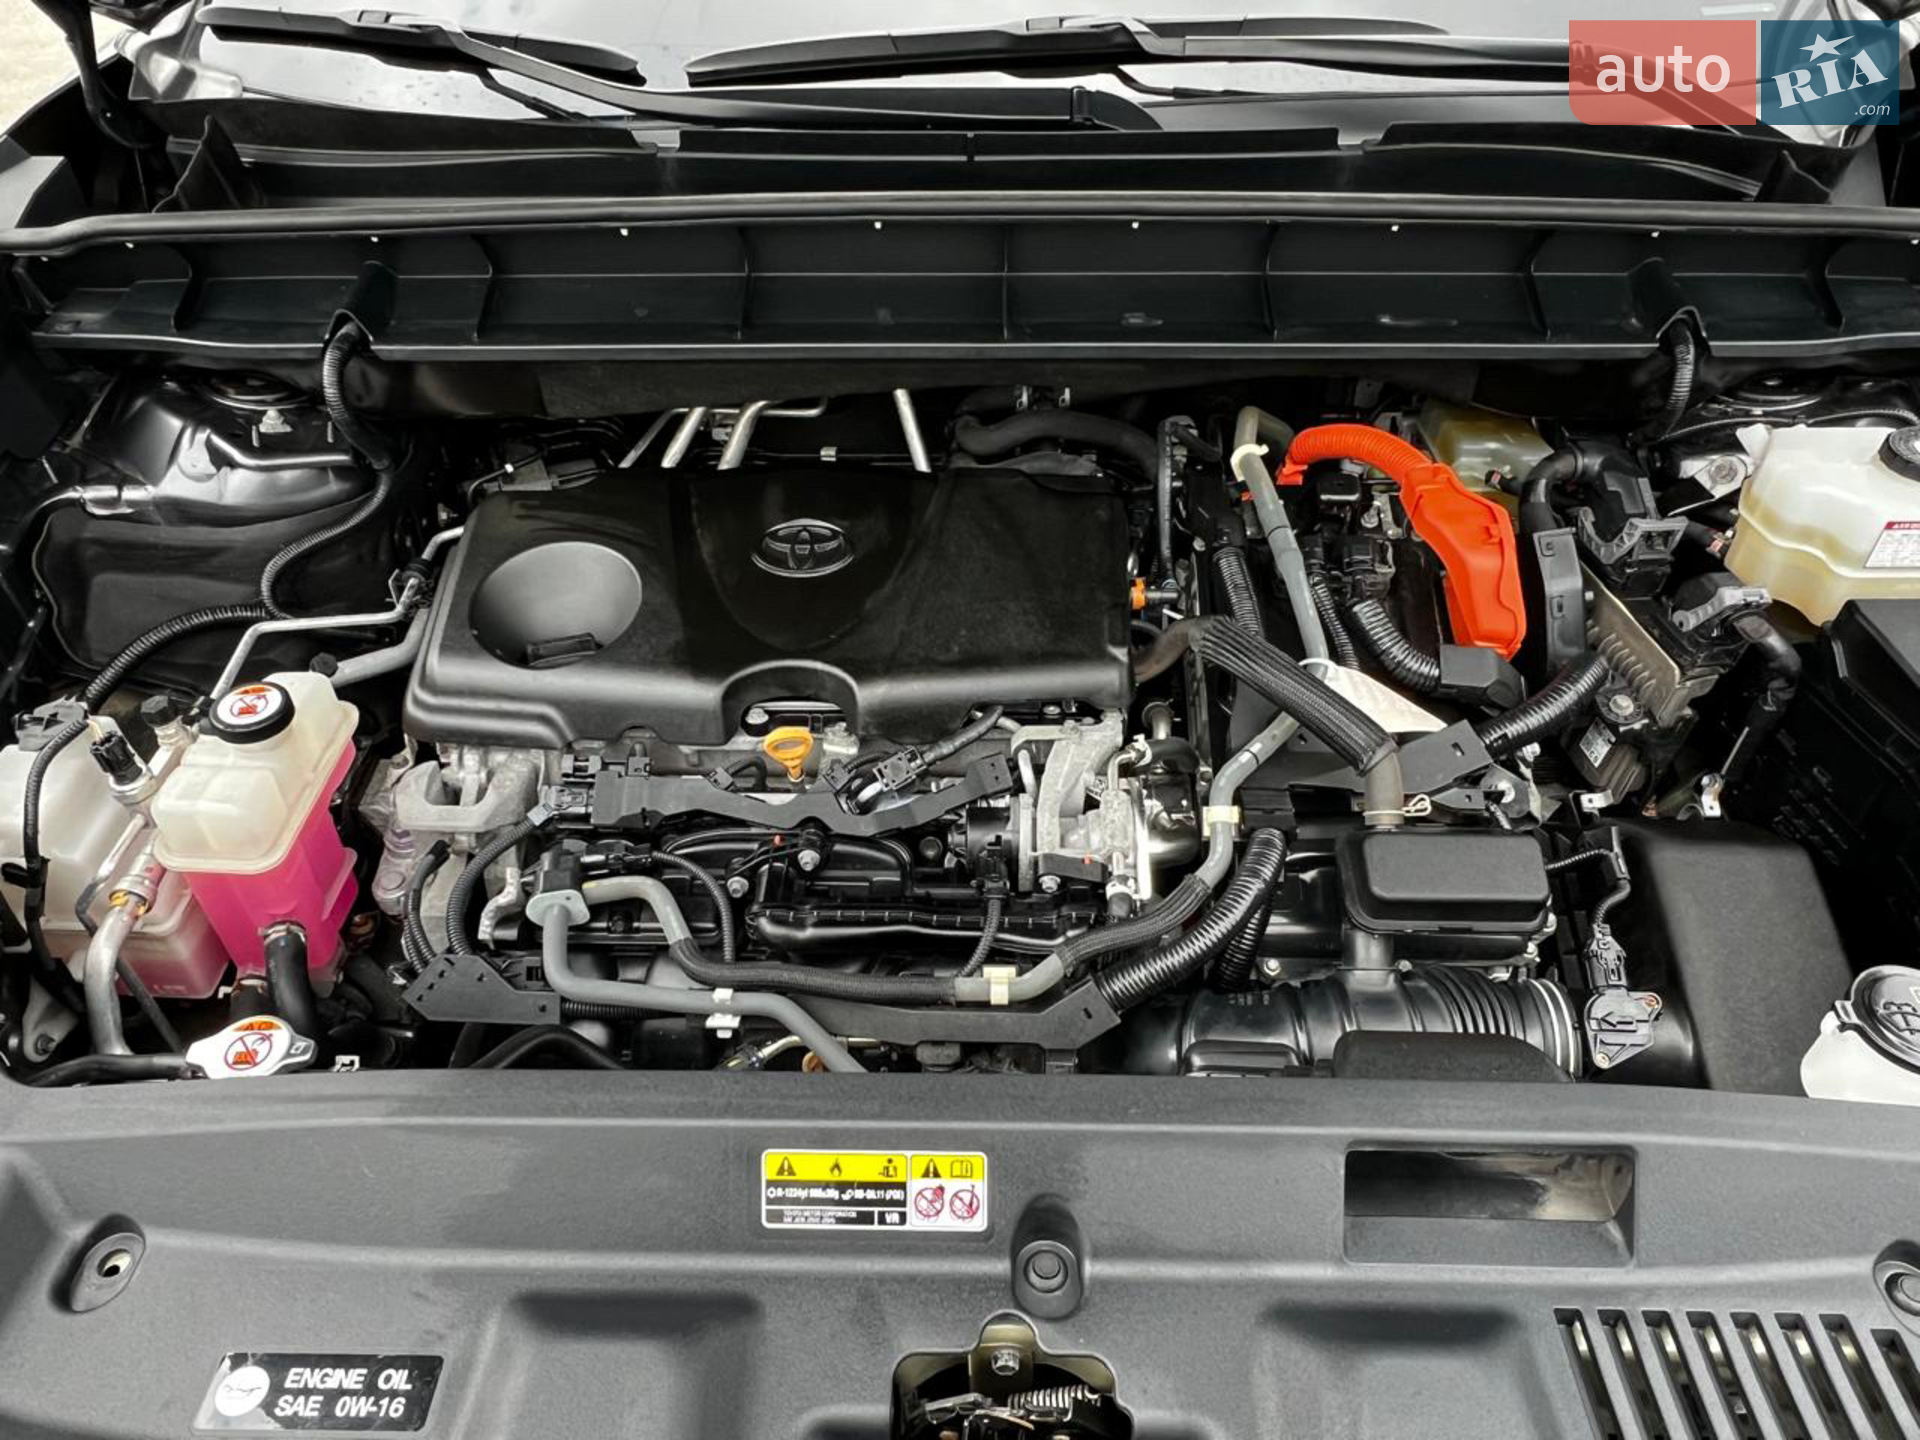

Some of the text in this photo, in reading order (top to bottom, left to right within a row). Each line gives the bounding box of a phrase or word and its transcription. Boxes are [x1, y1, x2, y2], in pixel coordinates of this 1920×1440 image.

[284, 1368, 412, 1390] ENGINE OIL
[274, 1395, 406, 1418] SAE 0W-16
